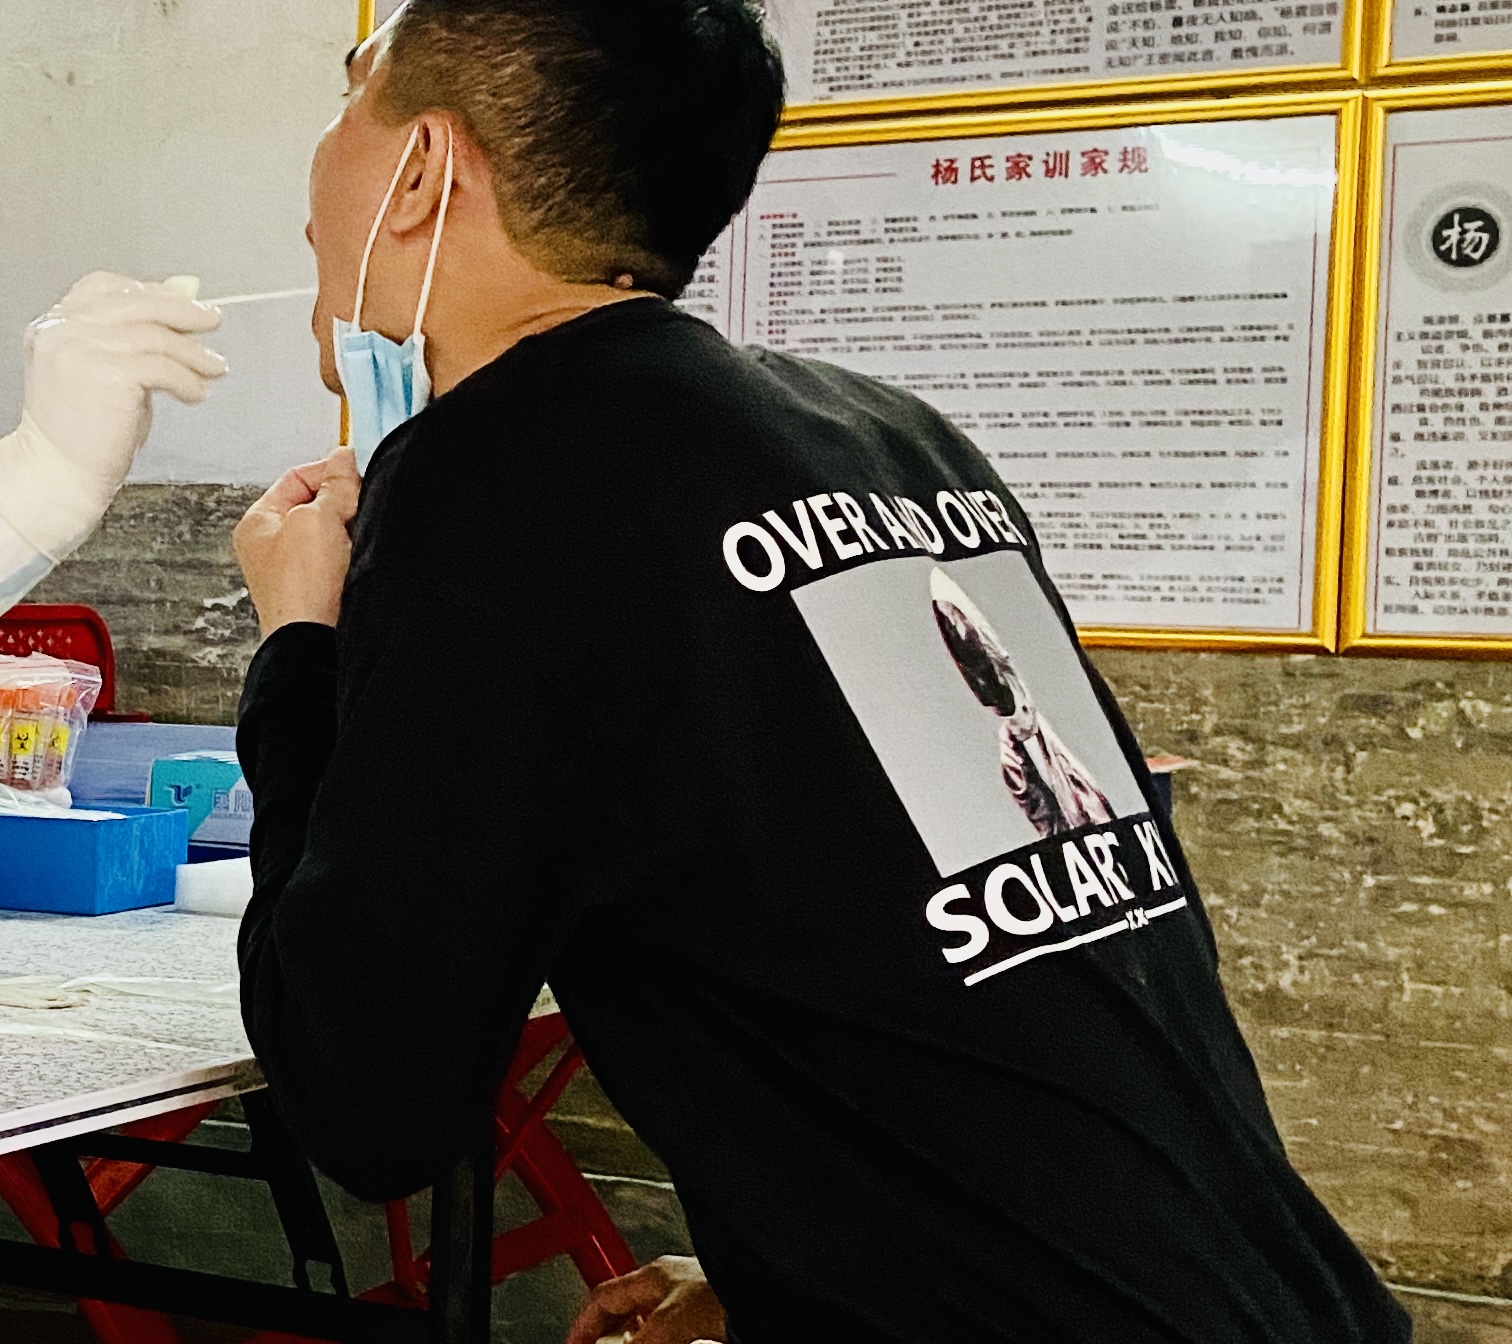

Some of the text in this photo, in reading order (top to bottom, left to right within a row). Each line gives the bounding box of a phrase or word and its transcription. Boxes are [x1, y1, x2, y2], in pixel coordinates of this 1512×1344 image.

[931, 146, 1149, 186] 杨氏家训家规
[1438, 212, 1490, 262] 杨
[723, 492, 890, 592] OVER
